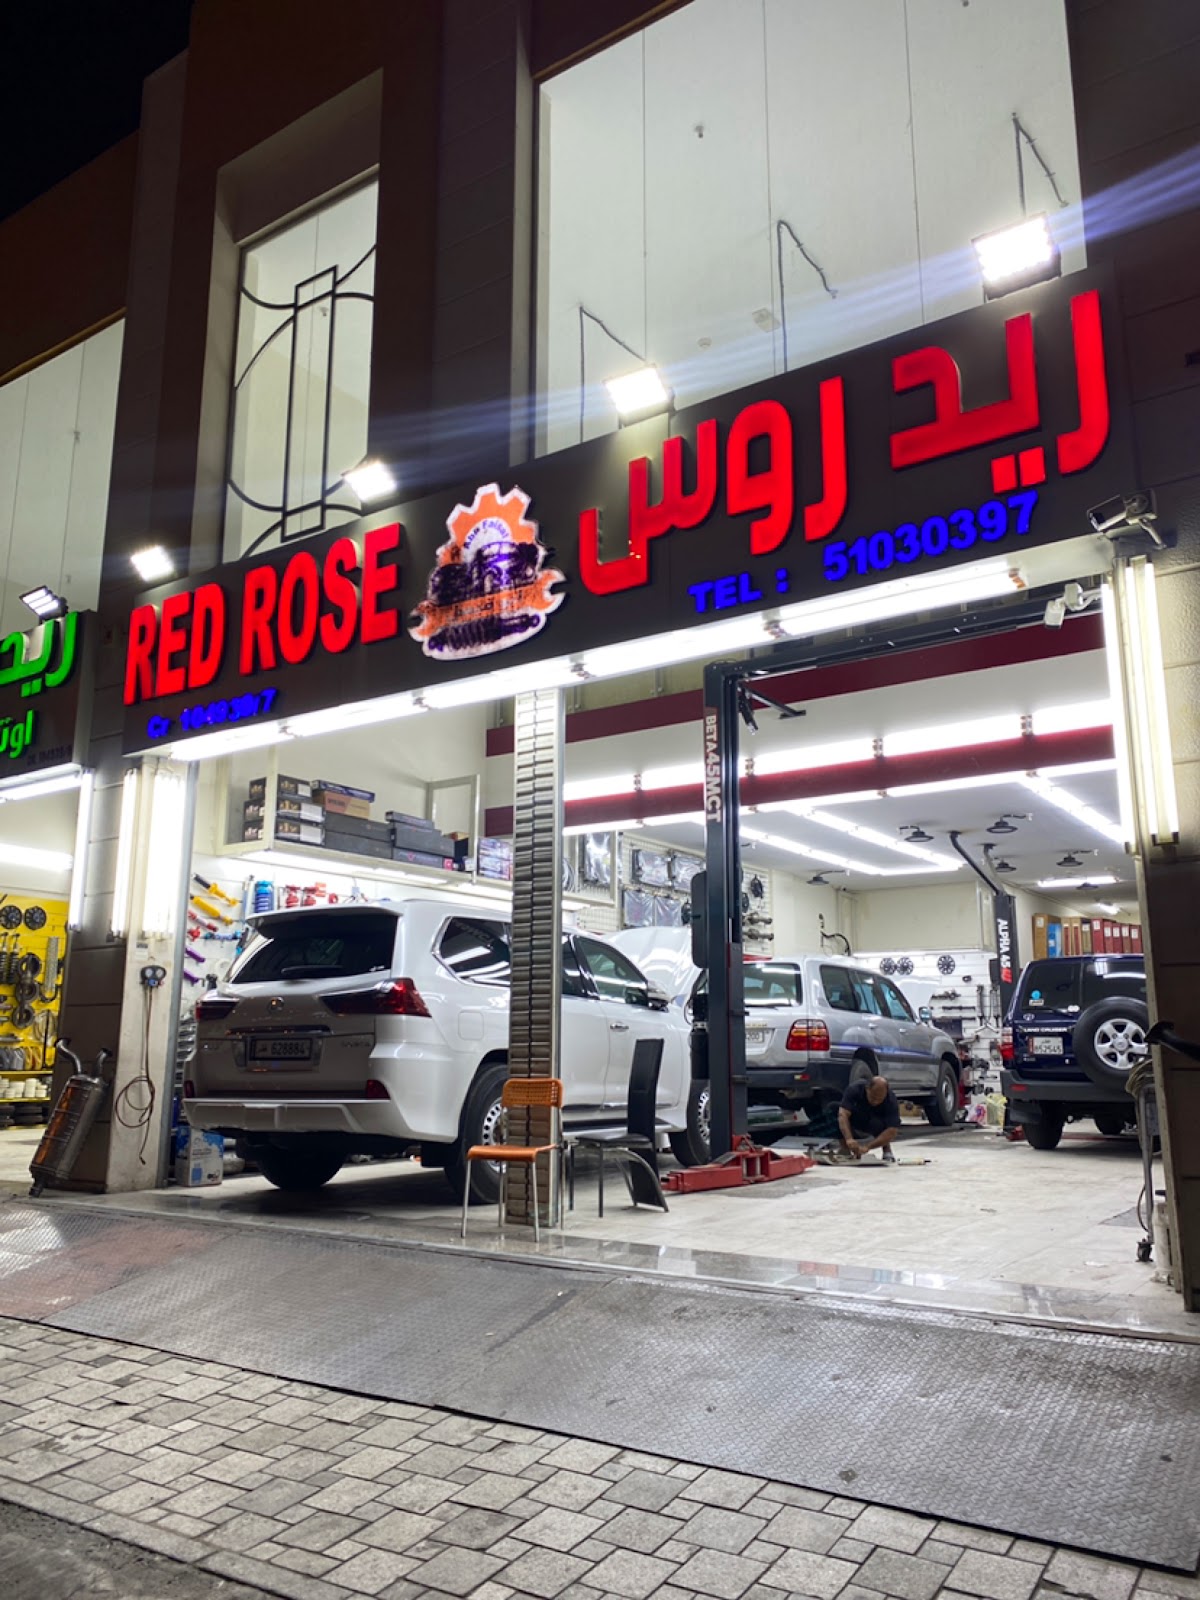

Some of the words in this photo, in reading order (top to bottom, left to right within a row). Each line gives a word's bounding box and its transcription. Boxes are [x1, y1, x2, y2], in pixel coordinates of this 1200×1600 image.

[891, 290, 1108, 487] ريد
[580, 377, 846, 595] روس
[688, 573, 762, 613] TEL
[823, 490, 1038, 581] 51030397
[123, 582, 225, 705] RED
[239, 522, 400, 674] ROSE
[997, 918, 1011, 953] ALPHA
